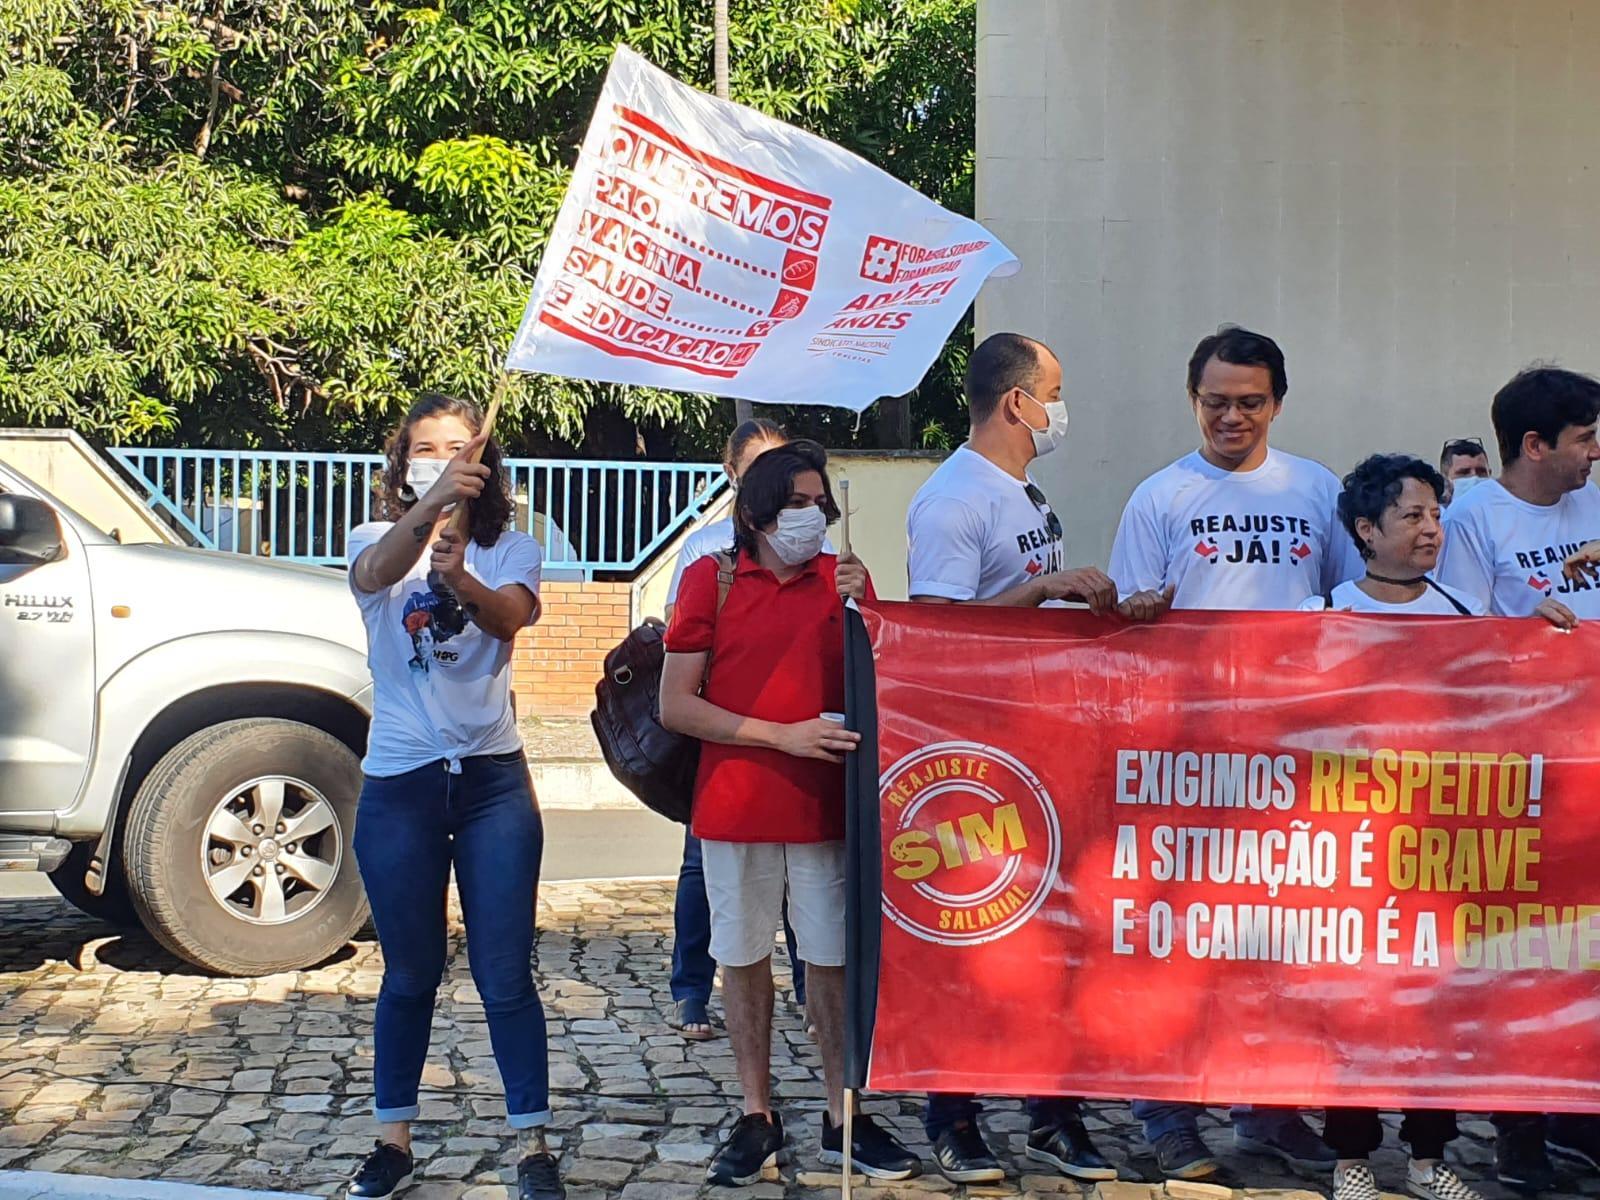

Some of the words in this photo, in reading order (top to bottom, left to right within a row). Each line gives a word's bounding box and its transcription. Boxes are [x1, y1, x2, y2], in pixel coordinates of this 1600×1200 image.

[601, 124, 829, 250] QUEREMOS
[577, 210, 702, 290] VACINA
[546, 279, 575, 311] E
[824, 311, 912, 330] ANDES
[1190, 514, 1311, 537] REAJUSTE
[1225, 534, 1281, 565] JÁ!
[5, 594, 73, 608] HILUX
[887, 758, 990, 808] REAJUSTE
[1115, 749, 1296, 811] EXIGIMOS
[1310, 747, 1544, 817] RESPEITO!
[889, 802, 1028, 881] SIM
[1112, 825, 1139, 880] A
[1151, 820, 1338, 897] SITUAÇÃO
[1350, 819, 1373, 888] É
[1388, 827, 1541, 893] GRAVE
[938, 884, 1032, 931] SALARIAL
[1112, 899, 1135, 955] E
[1149, 901, 1175, 959] O
[1186, 902, 1363, 966] CAMINHO
[1376, 896, 1400, 965] É
[1412, 911, 1440, 968] A
[1453, 903, 1600, 971] GREVE
